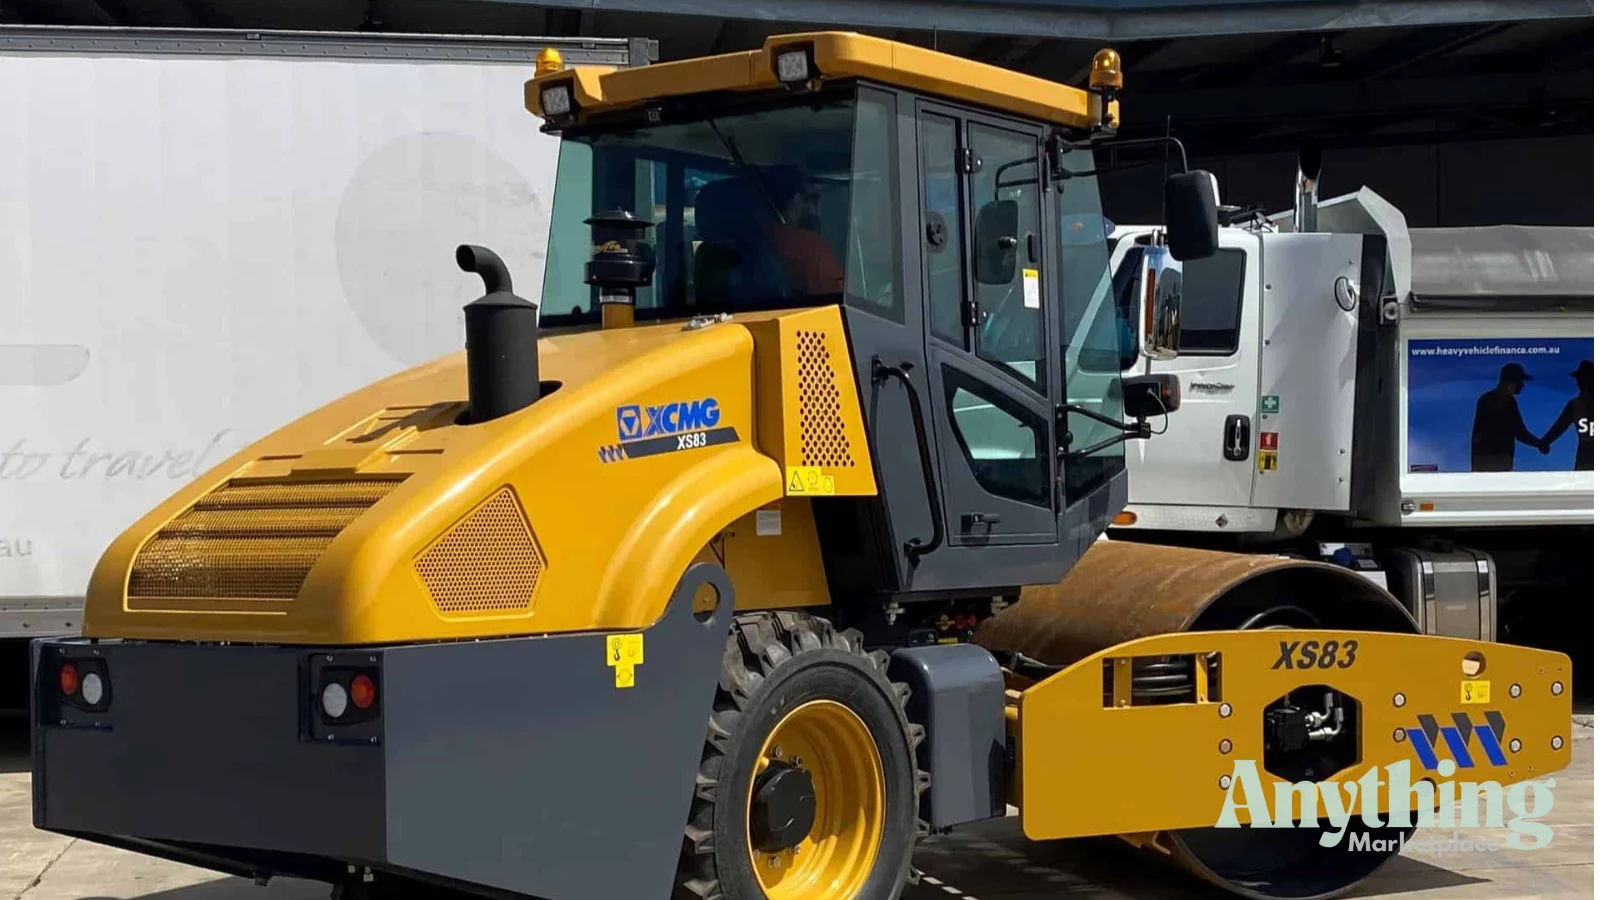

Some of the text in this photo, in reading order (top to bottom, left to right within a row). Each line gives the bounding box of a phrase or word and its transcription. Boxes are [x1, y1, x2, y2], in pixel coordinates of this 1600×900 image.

[1412, 346, 1560, 357] www.heavyvehiclefinance.com.au
[644, 398, 720, 436] XCMG
[0, 428, 231, 480] to travel
[677, 432, 707, 450] XS83
[1271, 640, 1359, 670] XS83
